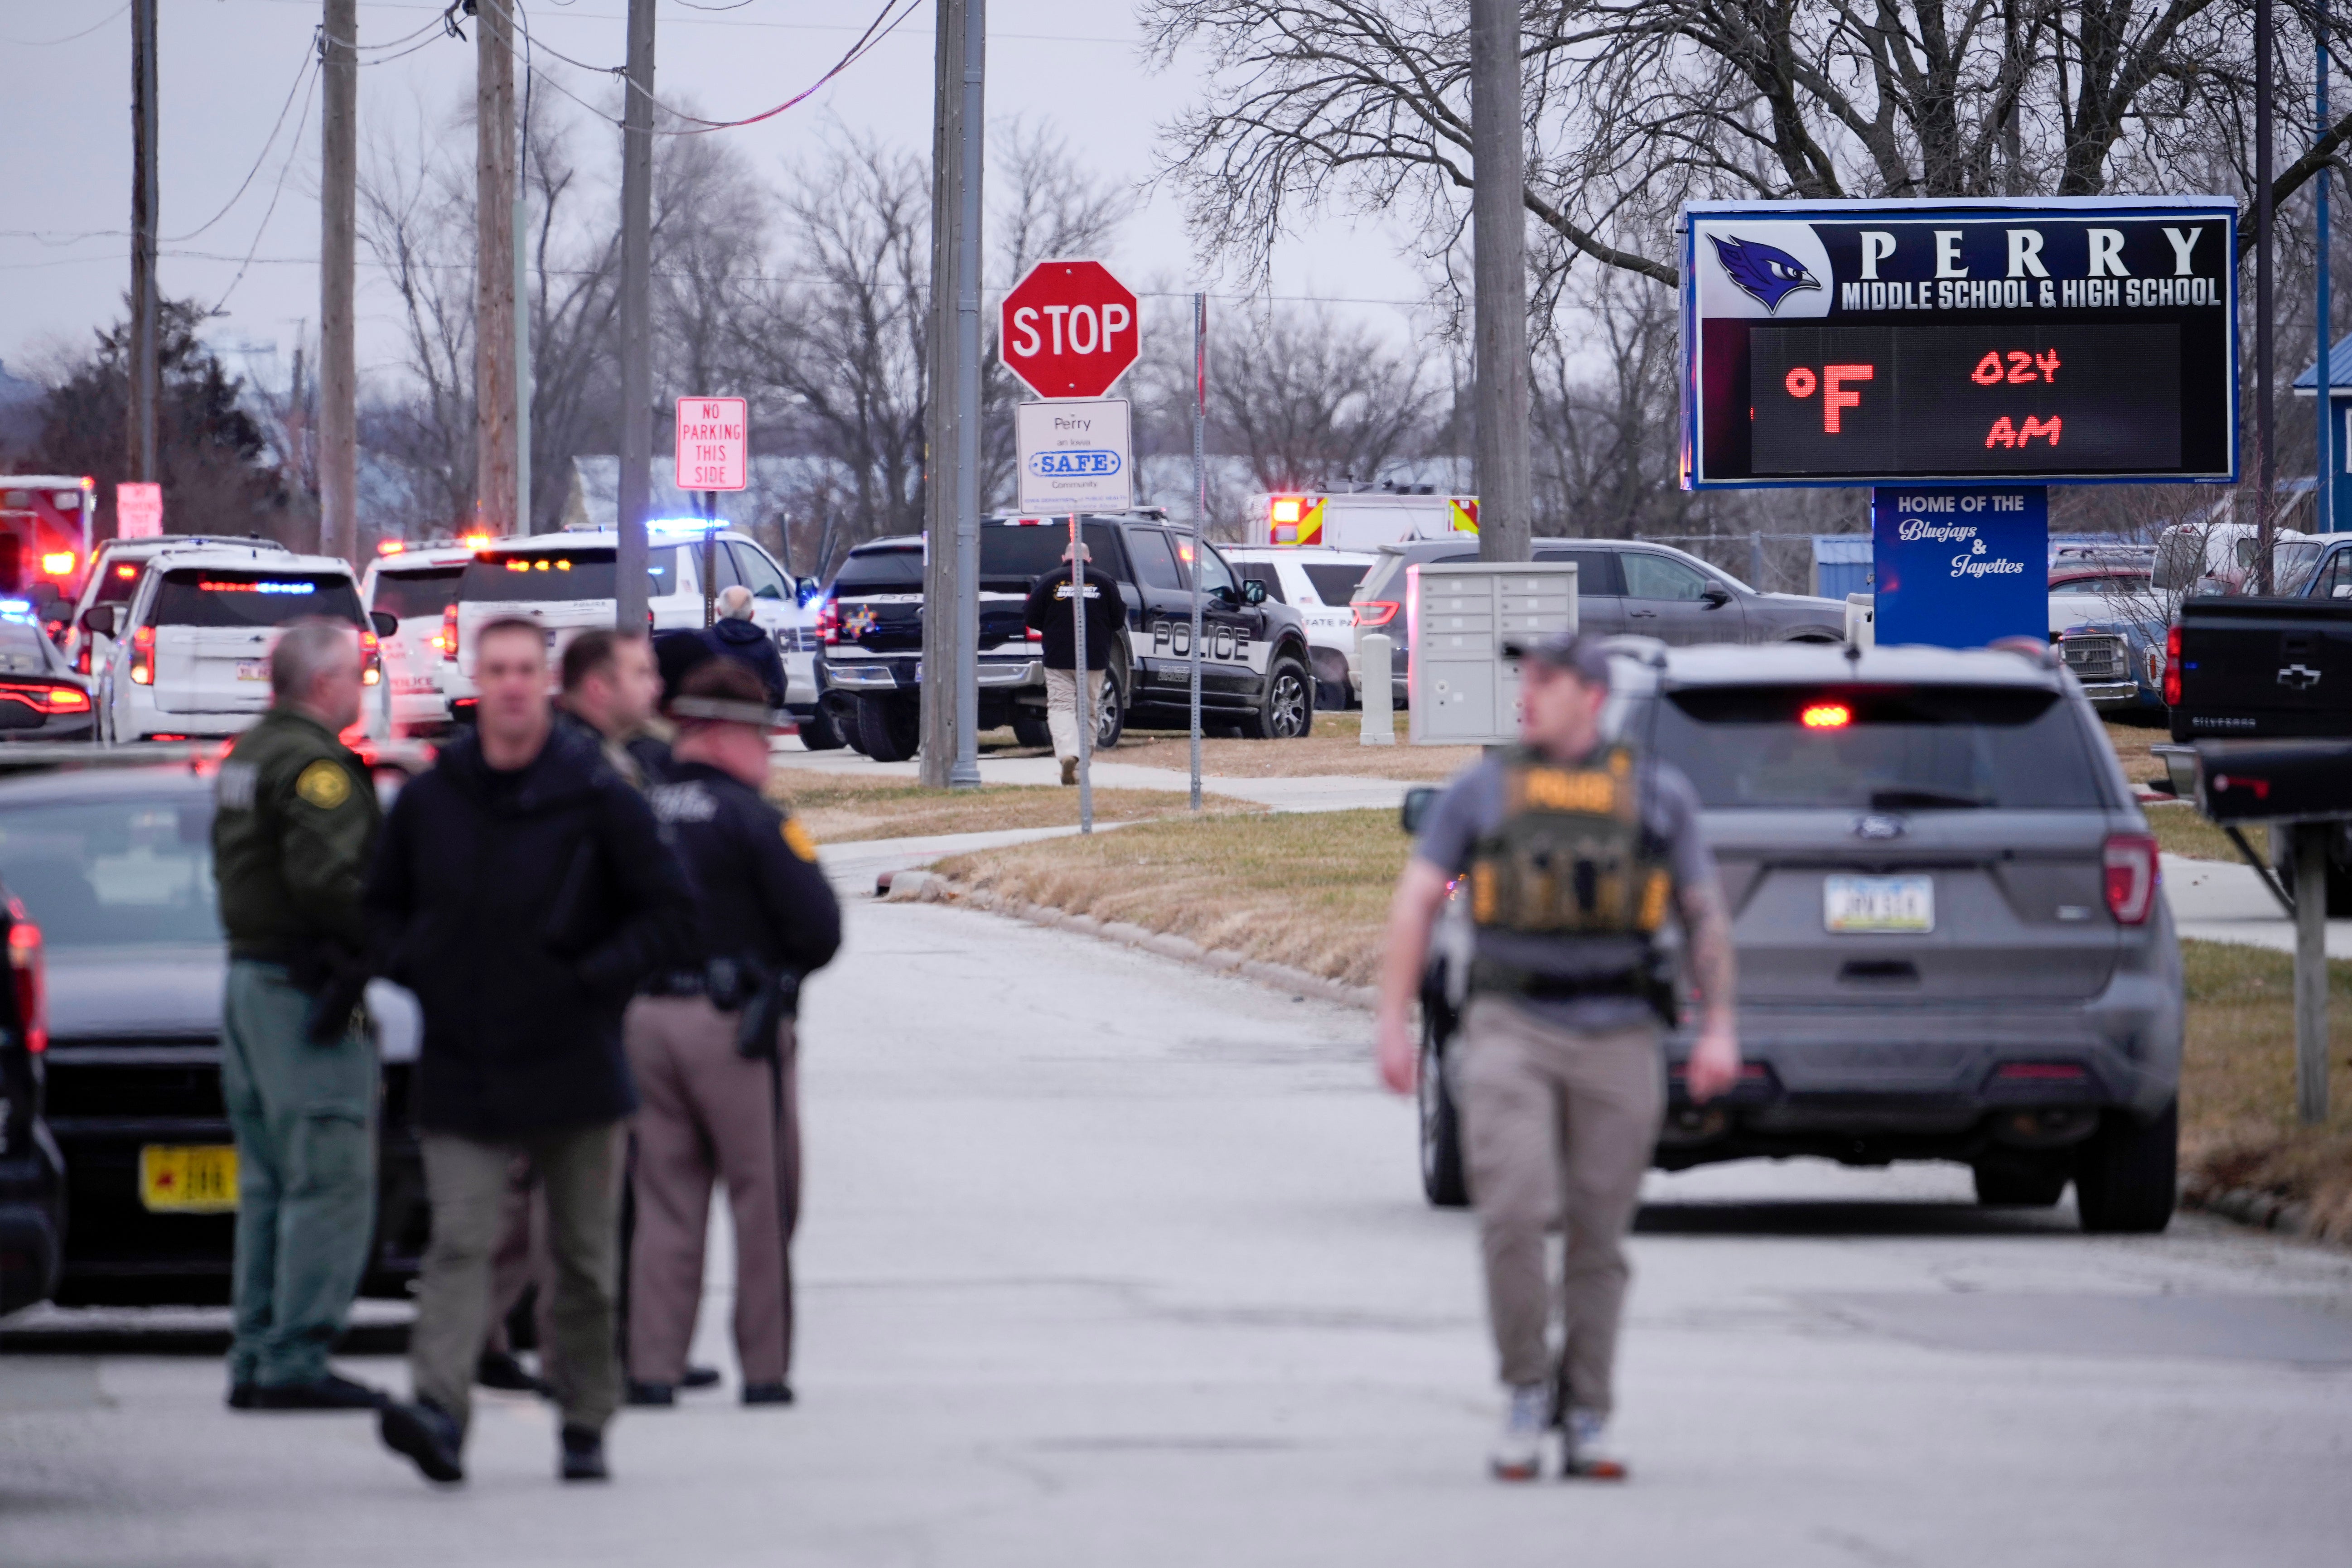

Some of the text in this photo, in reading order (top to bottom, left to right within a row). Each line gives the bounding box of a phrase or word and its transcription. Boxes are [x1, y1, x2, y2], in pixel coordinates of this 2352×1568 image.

[1859, 227, 2203, 280] PERRY
[1842, 277, 2221, 310] MIDDLE SCHOOL & HIGH SCHOOL
[1012, 304, 1130, 358] STOP
[703, 403, 720, 419] NO
[683, 424, 741, 440] PARKING
[1054, 418, 1091, 431] Perry
[1985, 415, 2062, 448] AM
[696, 445, 726, 461] THIS
[1042, 454, 1107, 472] SAFE
[695, 466, 726, 484] SIDE
[1052, 481, 1097, 489] Community
[1898, 495, 2024, 512] HOME OF THE
[1898, 518, 1978, 542] Bluejays
[1971, 539, 1987, 555] &
[1950, 554, 2024, 578] Jayettes
[1153, 620, 1251, 661] POICE
